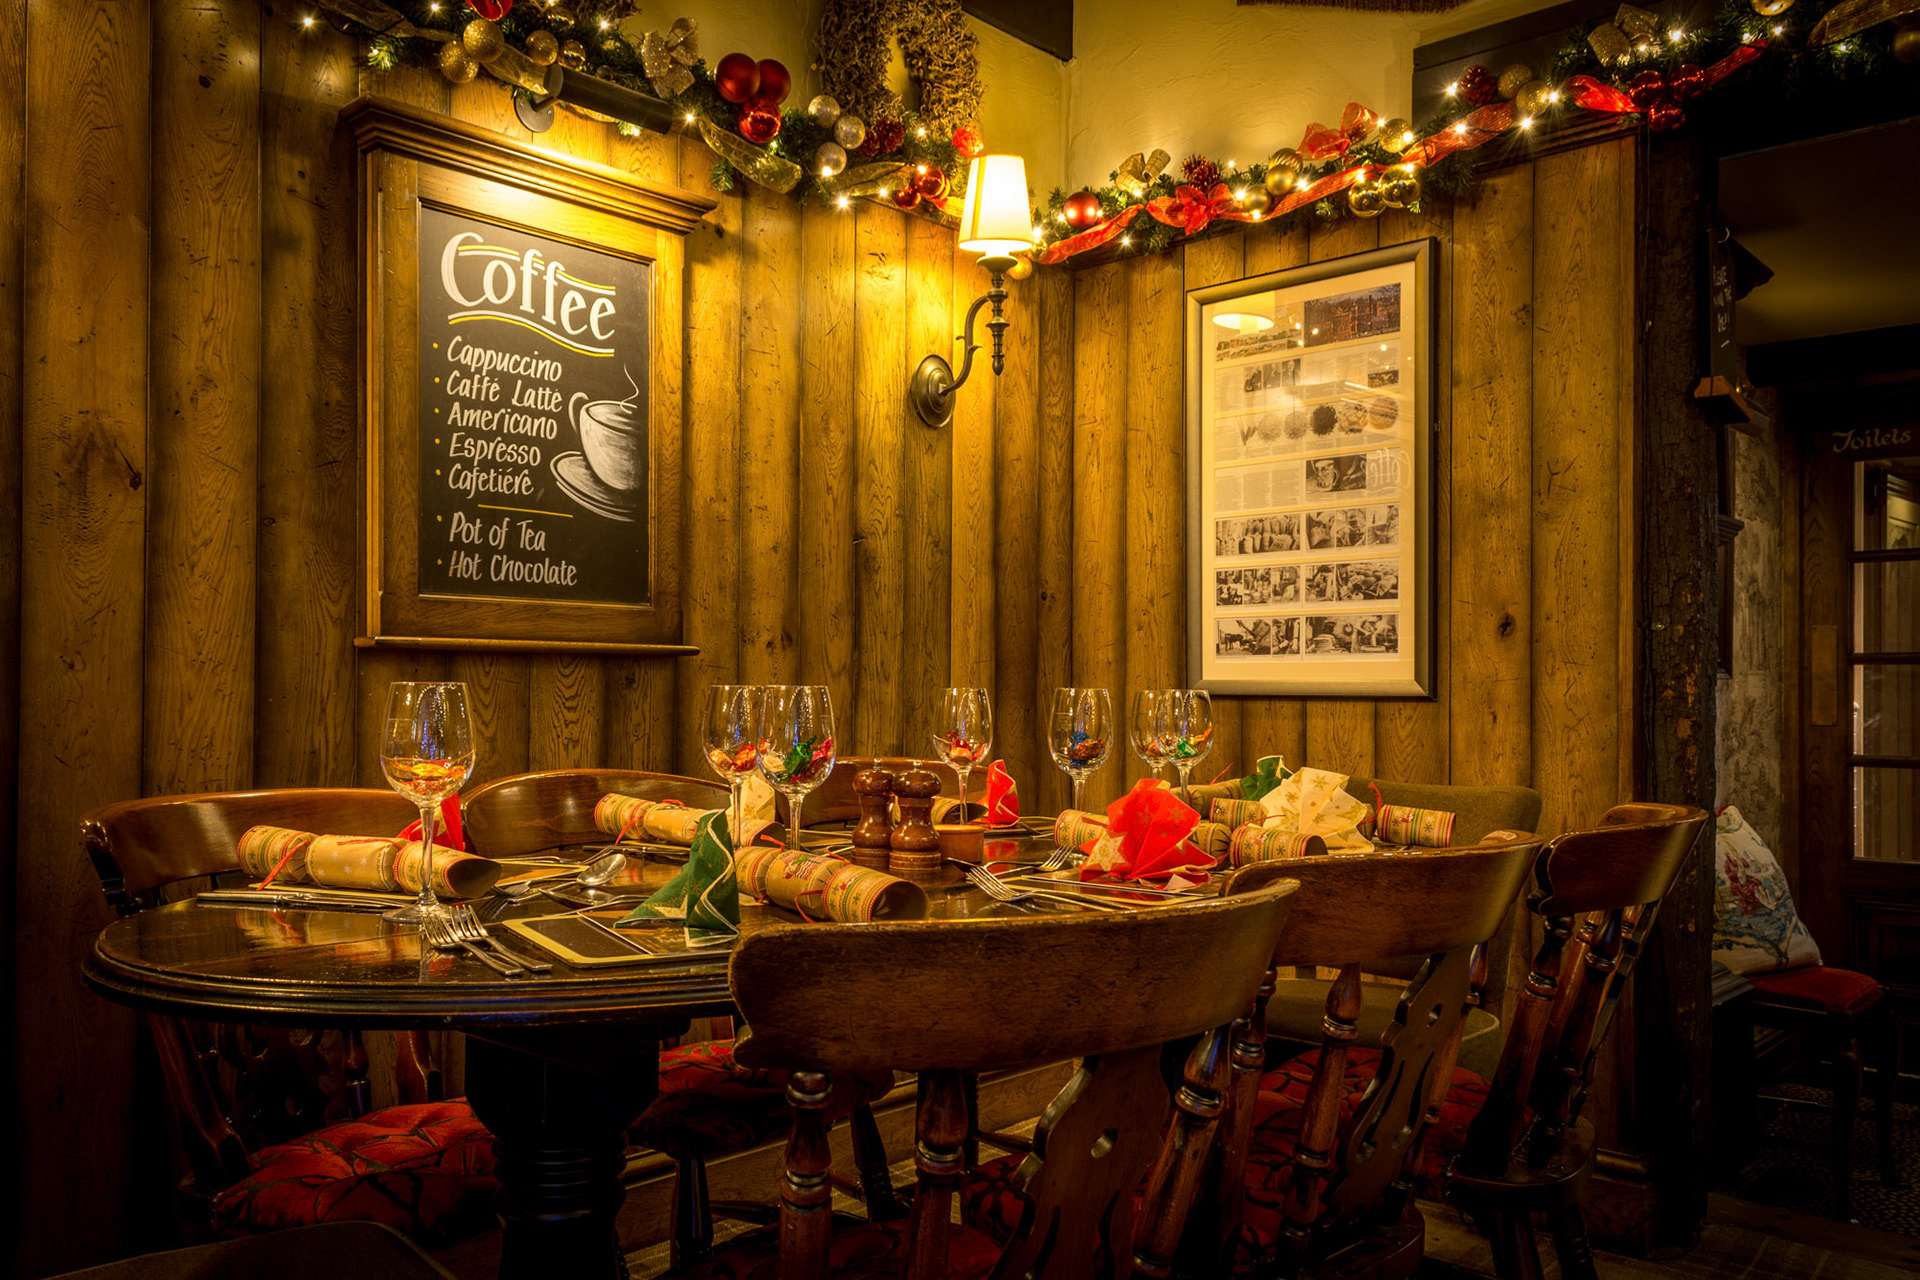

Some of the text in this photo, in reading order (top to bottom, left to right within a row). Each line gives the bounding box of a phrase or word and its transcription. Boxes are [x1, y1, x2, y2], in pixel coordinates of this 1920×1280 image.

[441, 232, 616, 340] Coffee
[447, 335, 563, 382] Cappuccino
[447, 402, 558, 440] Americano
[449, 432, 541, 467] Espresso
[1832, 428, 1912, 453] Toilets
[449, 511, 546, 551] Pot of Tea
[448, 550, 578, 586] Hot Chocolate
